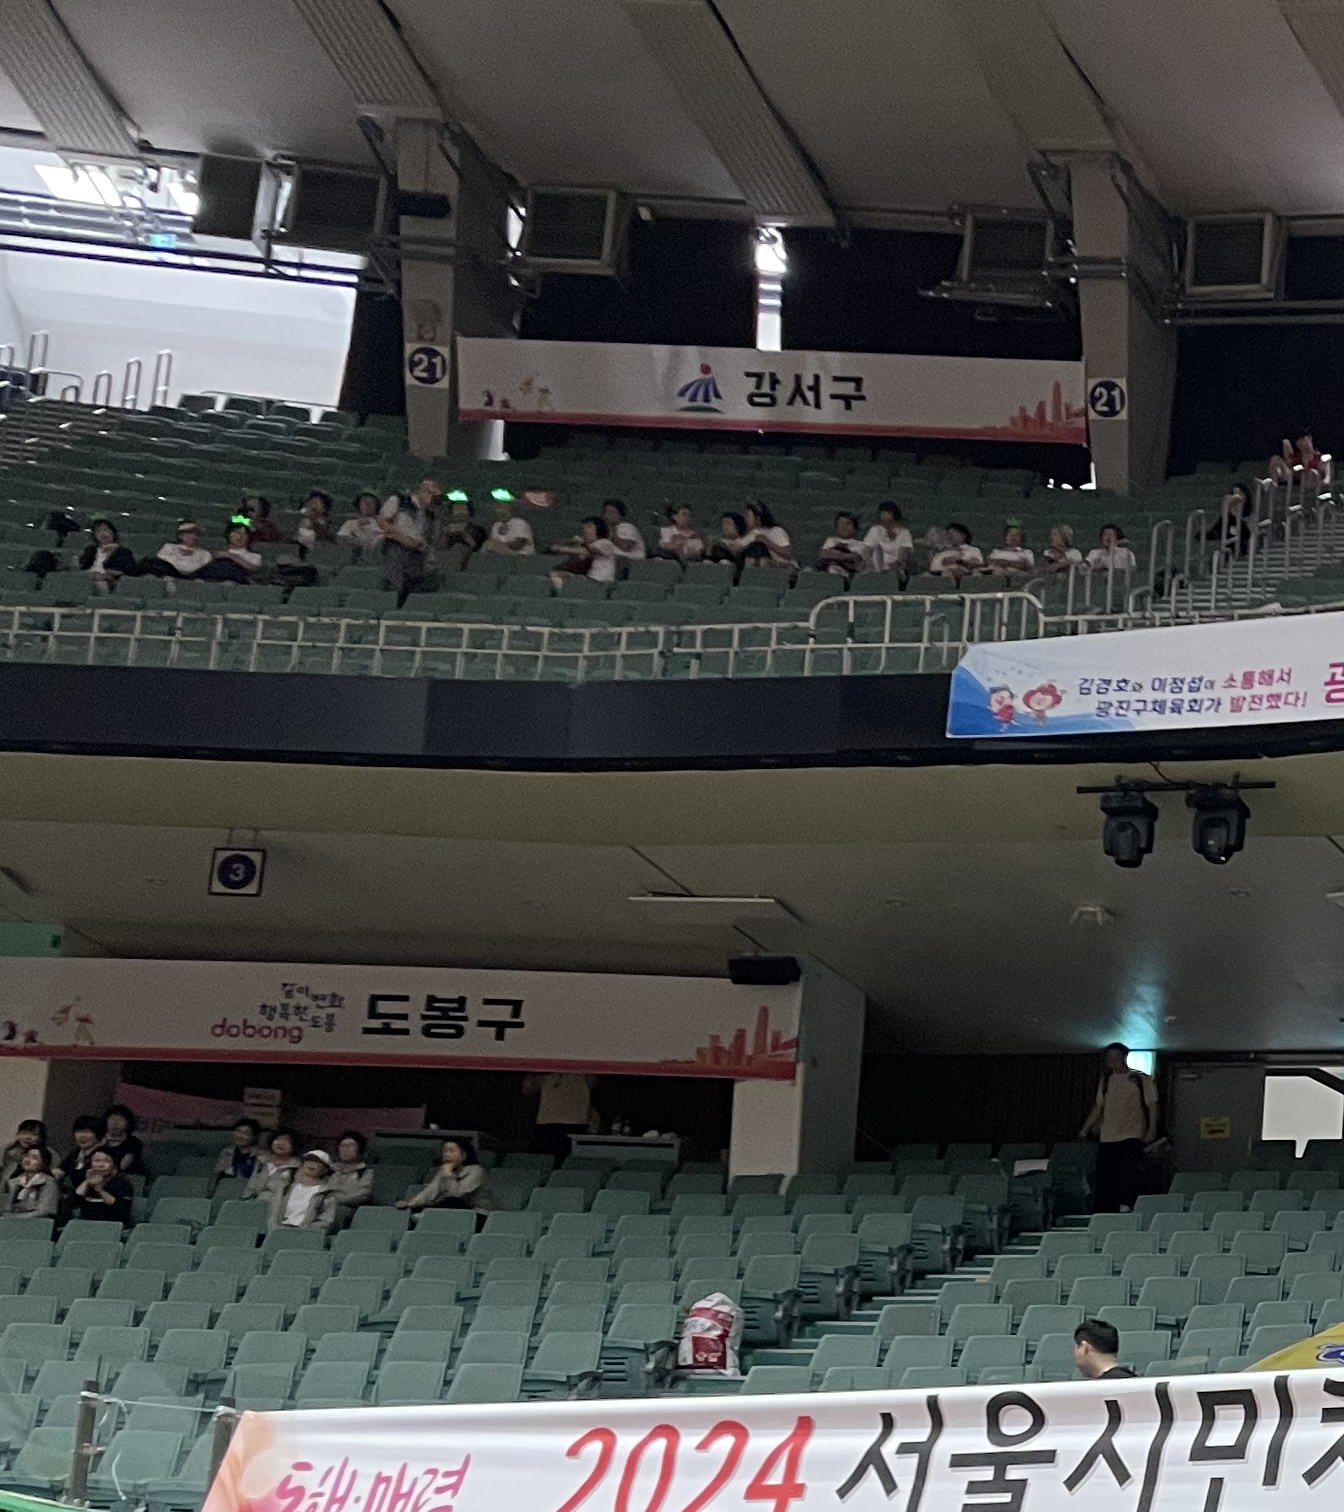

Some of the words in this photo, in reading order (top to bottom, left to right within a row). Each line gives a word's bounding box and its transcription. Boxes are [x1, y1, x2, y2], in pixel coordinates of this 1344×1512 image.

[413, 353, 442, 379] 21
[743, 368, 867, 412] 강서구
[1094, 386, 1121, 412] 21
[229, 861, 246, 882] 3
[210, 1017, 304, 1044] dobong
[361, 993, 526, 1042] 도봉구
